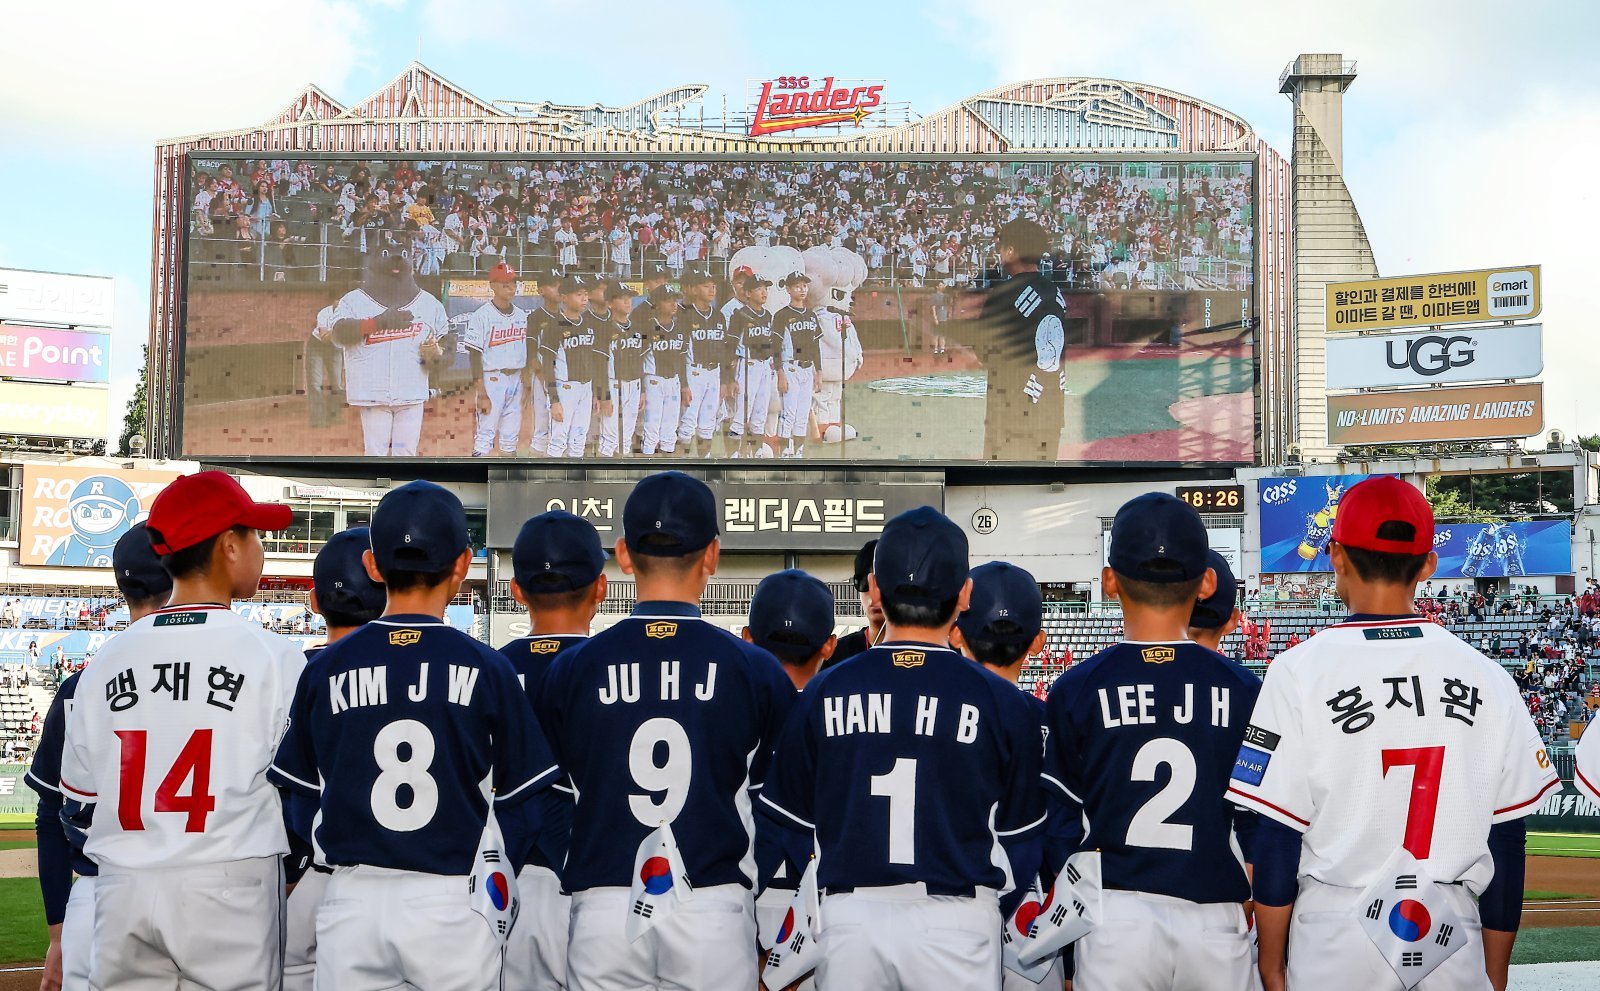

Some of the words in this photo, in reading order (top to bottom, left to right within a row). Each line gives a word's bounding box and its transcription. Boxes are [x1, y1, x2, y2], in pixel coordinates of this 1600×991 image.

[778, 76, 810, 89] SSG
[751, 77, 884, 137] Landers
[1335, 288, 1378, 306] 할인과
[1381, 285, 1424, 302] 결제를
[1428, 281, 1476, 299] 한번에!
[1492, 279, 1529, 292] emart
[1335, 307, 1378, 324] 이마트
[1381, 306, 1396, 321] 갈
[1400, 303, 1418, 320] 땐,
[1422, 299, 1480, 318] 이마트앱
[23, 336, 103, 368] Point
[1385, 335, 1476, 376] UGG
[1409, 403, 1470, 423] AMAZING
[1473, 400, 1535, 419] LANDERS
[1182, 490, 1239, 507] 18:26
[655, 520, 662, 529] 9
[724, 497, 886, 534] 랜더스필드
[977, 515, 991, 528] 26
[404, 534, 411, 543] 8
[1158, 545, 1165, 553] 2
[544, 562, 551, 570] 3
[334, 580, 343, 589] 10
[165, 617, 195, 625] JOSUN
[999, 609, 1009, 617] 12
[329, 665, 388, 715] KIM
[408, 662, 430, 702] J
[447, 664, 480, 707] W
[598, 662, 641, 705] JU
[660, 661, 680, 701] H
[694, 662, 717, 701] J
[823, 693, 892, 737] HAN
[914, 695, 939, 737] H
[956, 703, 980, 744] B
[1097, 684, 1156, 729] LEE
[1173, 683, 1194, 724] J
[1211, 686, 1230, 728] H
[113, 728, 216, 833] 14
[370, 719, 439, 832] 8
[628, 717, 692, 828] 9
[1248, 763, 1263, 773] AIR
[1124, 737, 1197, 851] 2
[1381, 745, 1446, 860] 7
[870, 757, 917, 865] 1
